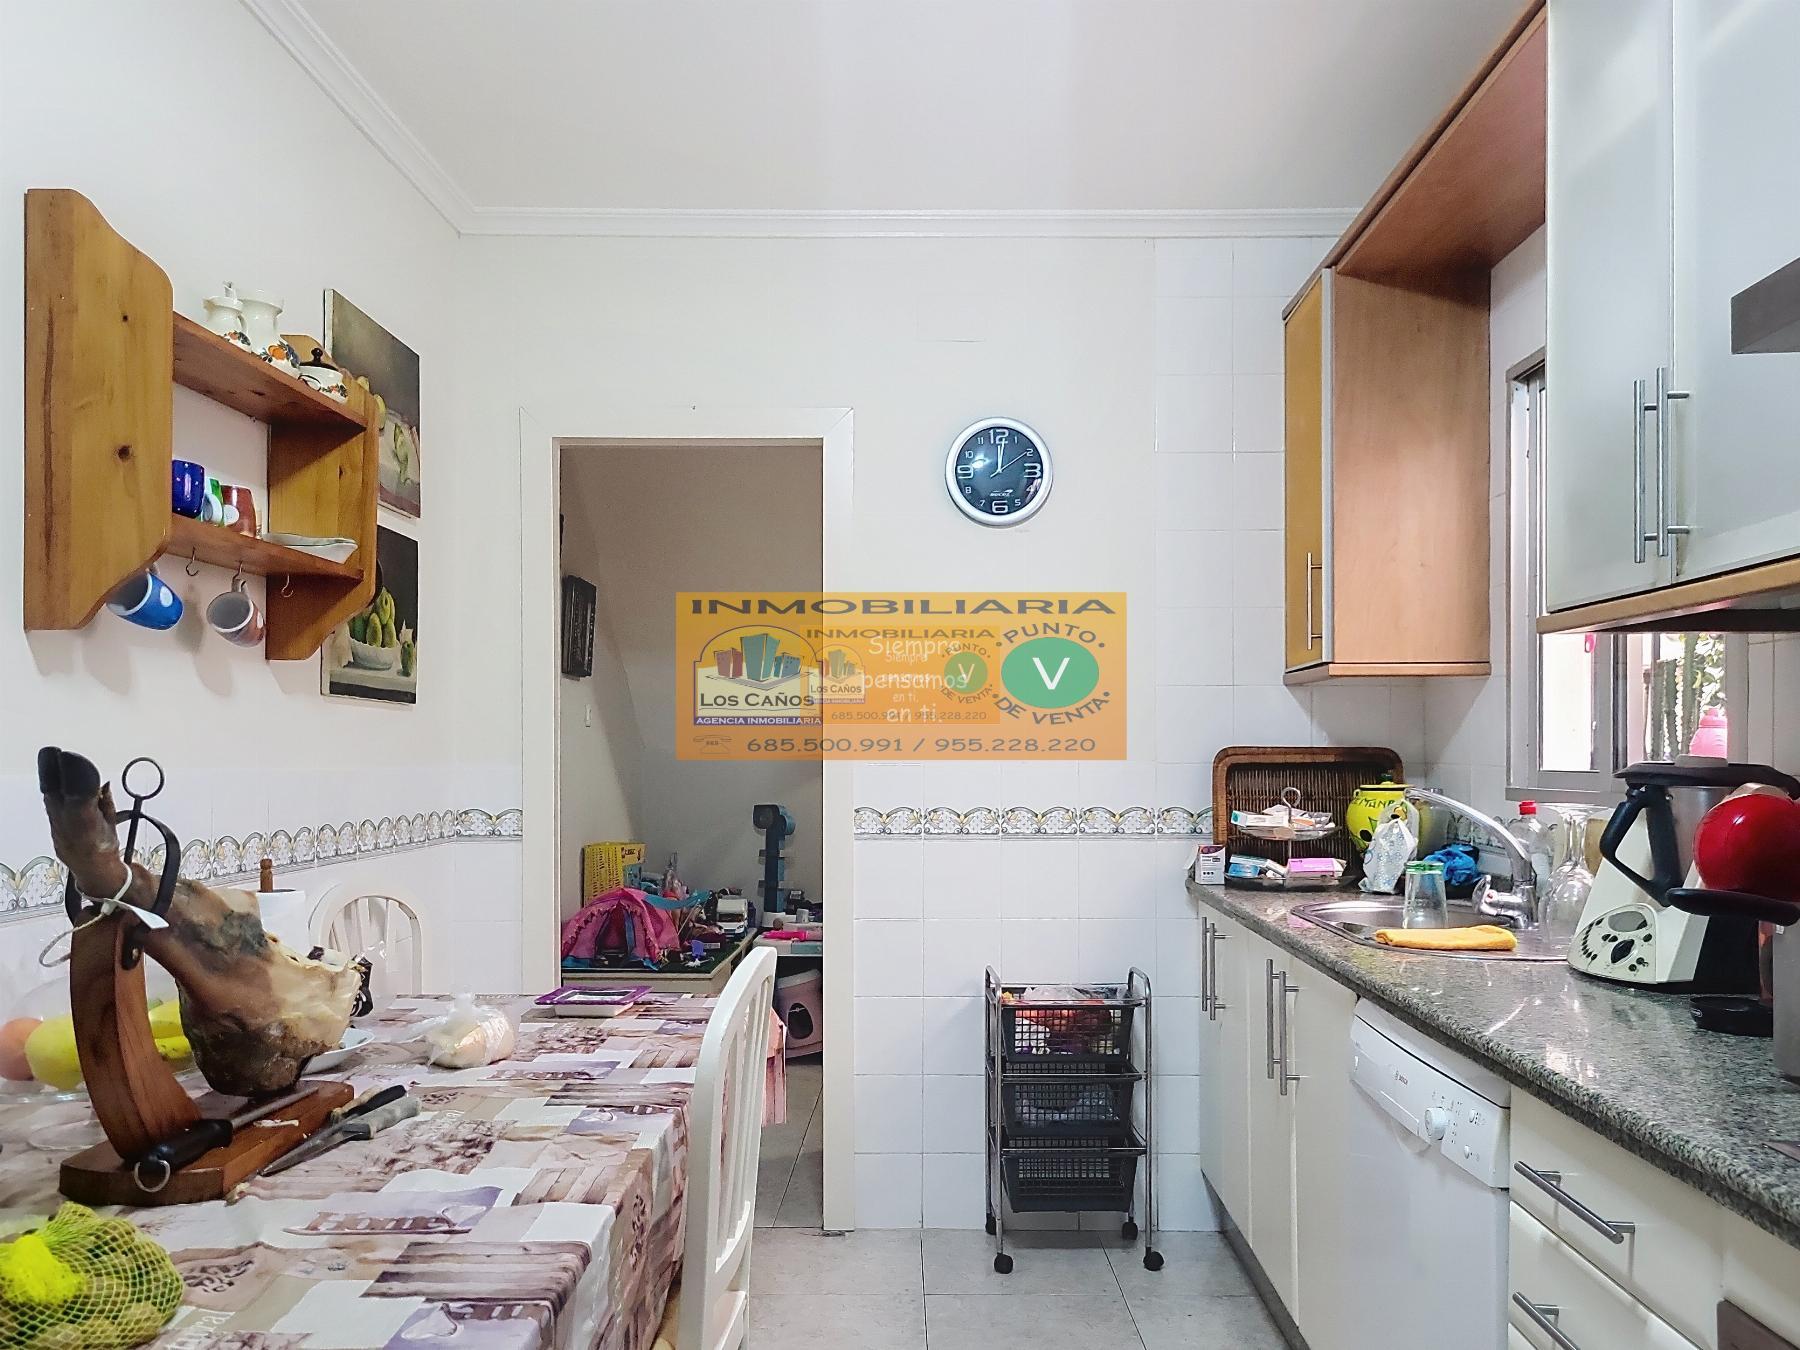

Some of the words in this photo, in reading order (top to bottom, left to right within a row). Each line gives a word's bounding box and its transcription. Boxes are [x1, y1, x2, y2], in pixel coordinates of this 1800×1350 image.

[989, 429, 1009, 444] 12
[965, 451, 973, 459] 10
[1026, 448, 1033, 456] 2
[957, 465, 974, 479] 9
[1023, 463, 1041, 478] 3
[991, 501, 1008, 513] 6
